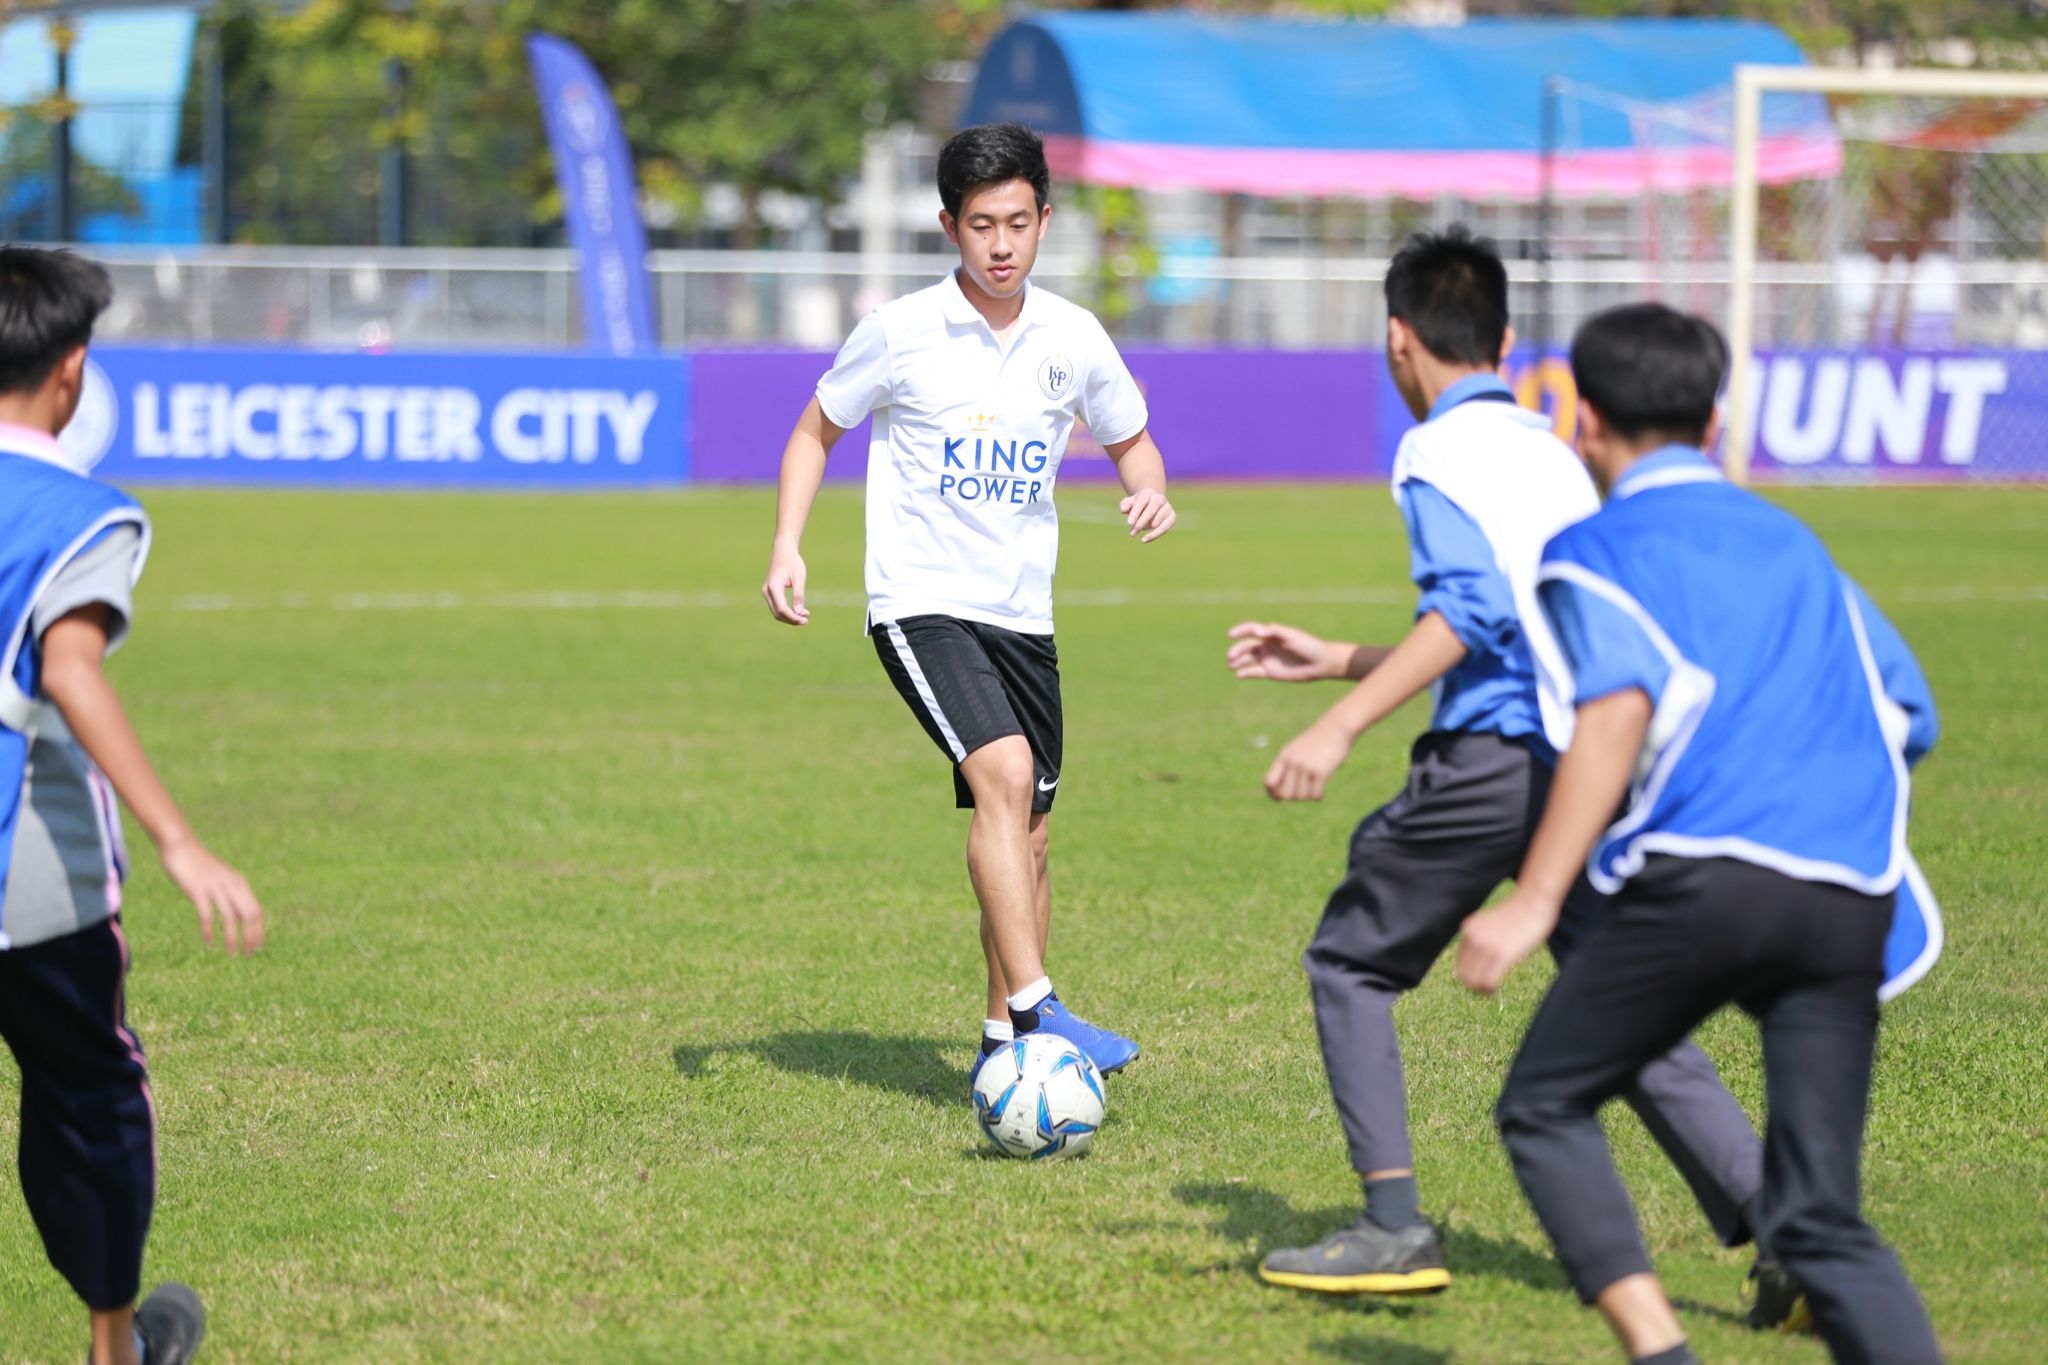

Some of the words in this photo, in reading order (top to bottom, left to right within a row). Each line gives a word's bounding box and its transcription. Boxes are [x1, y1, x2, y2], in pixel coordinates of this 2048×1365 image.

[133, 382, 485, 461] LEICESTER
[490, 387, 659, 464] CITY
[943, 437, 1047, 474] KING
[940, 474, 1042, 504] POWER
